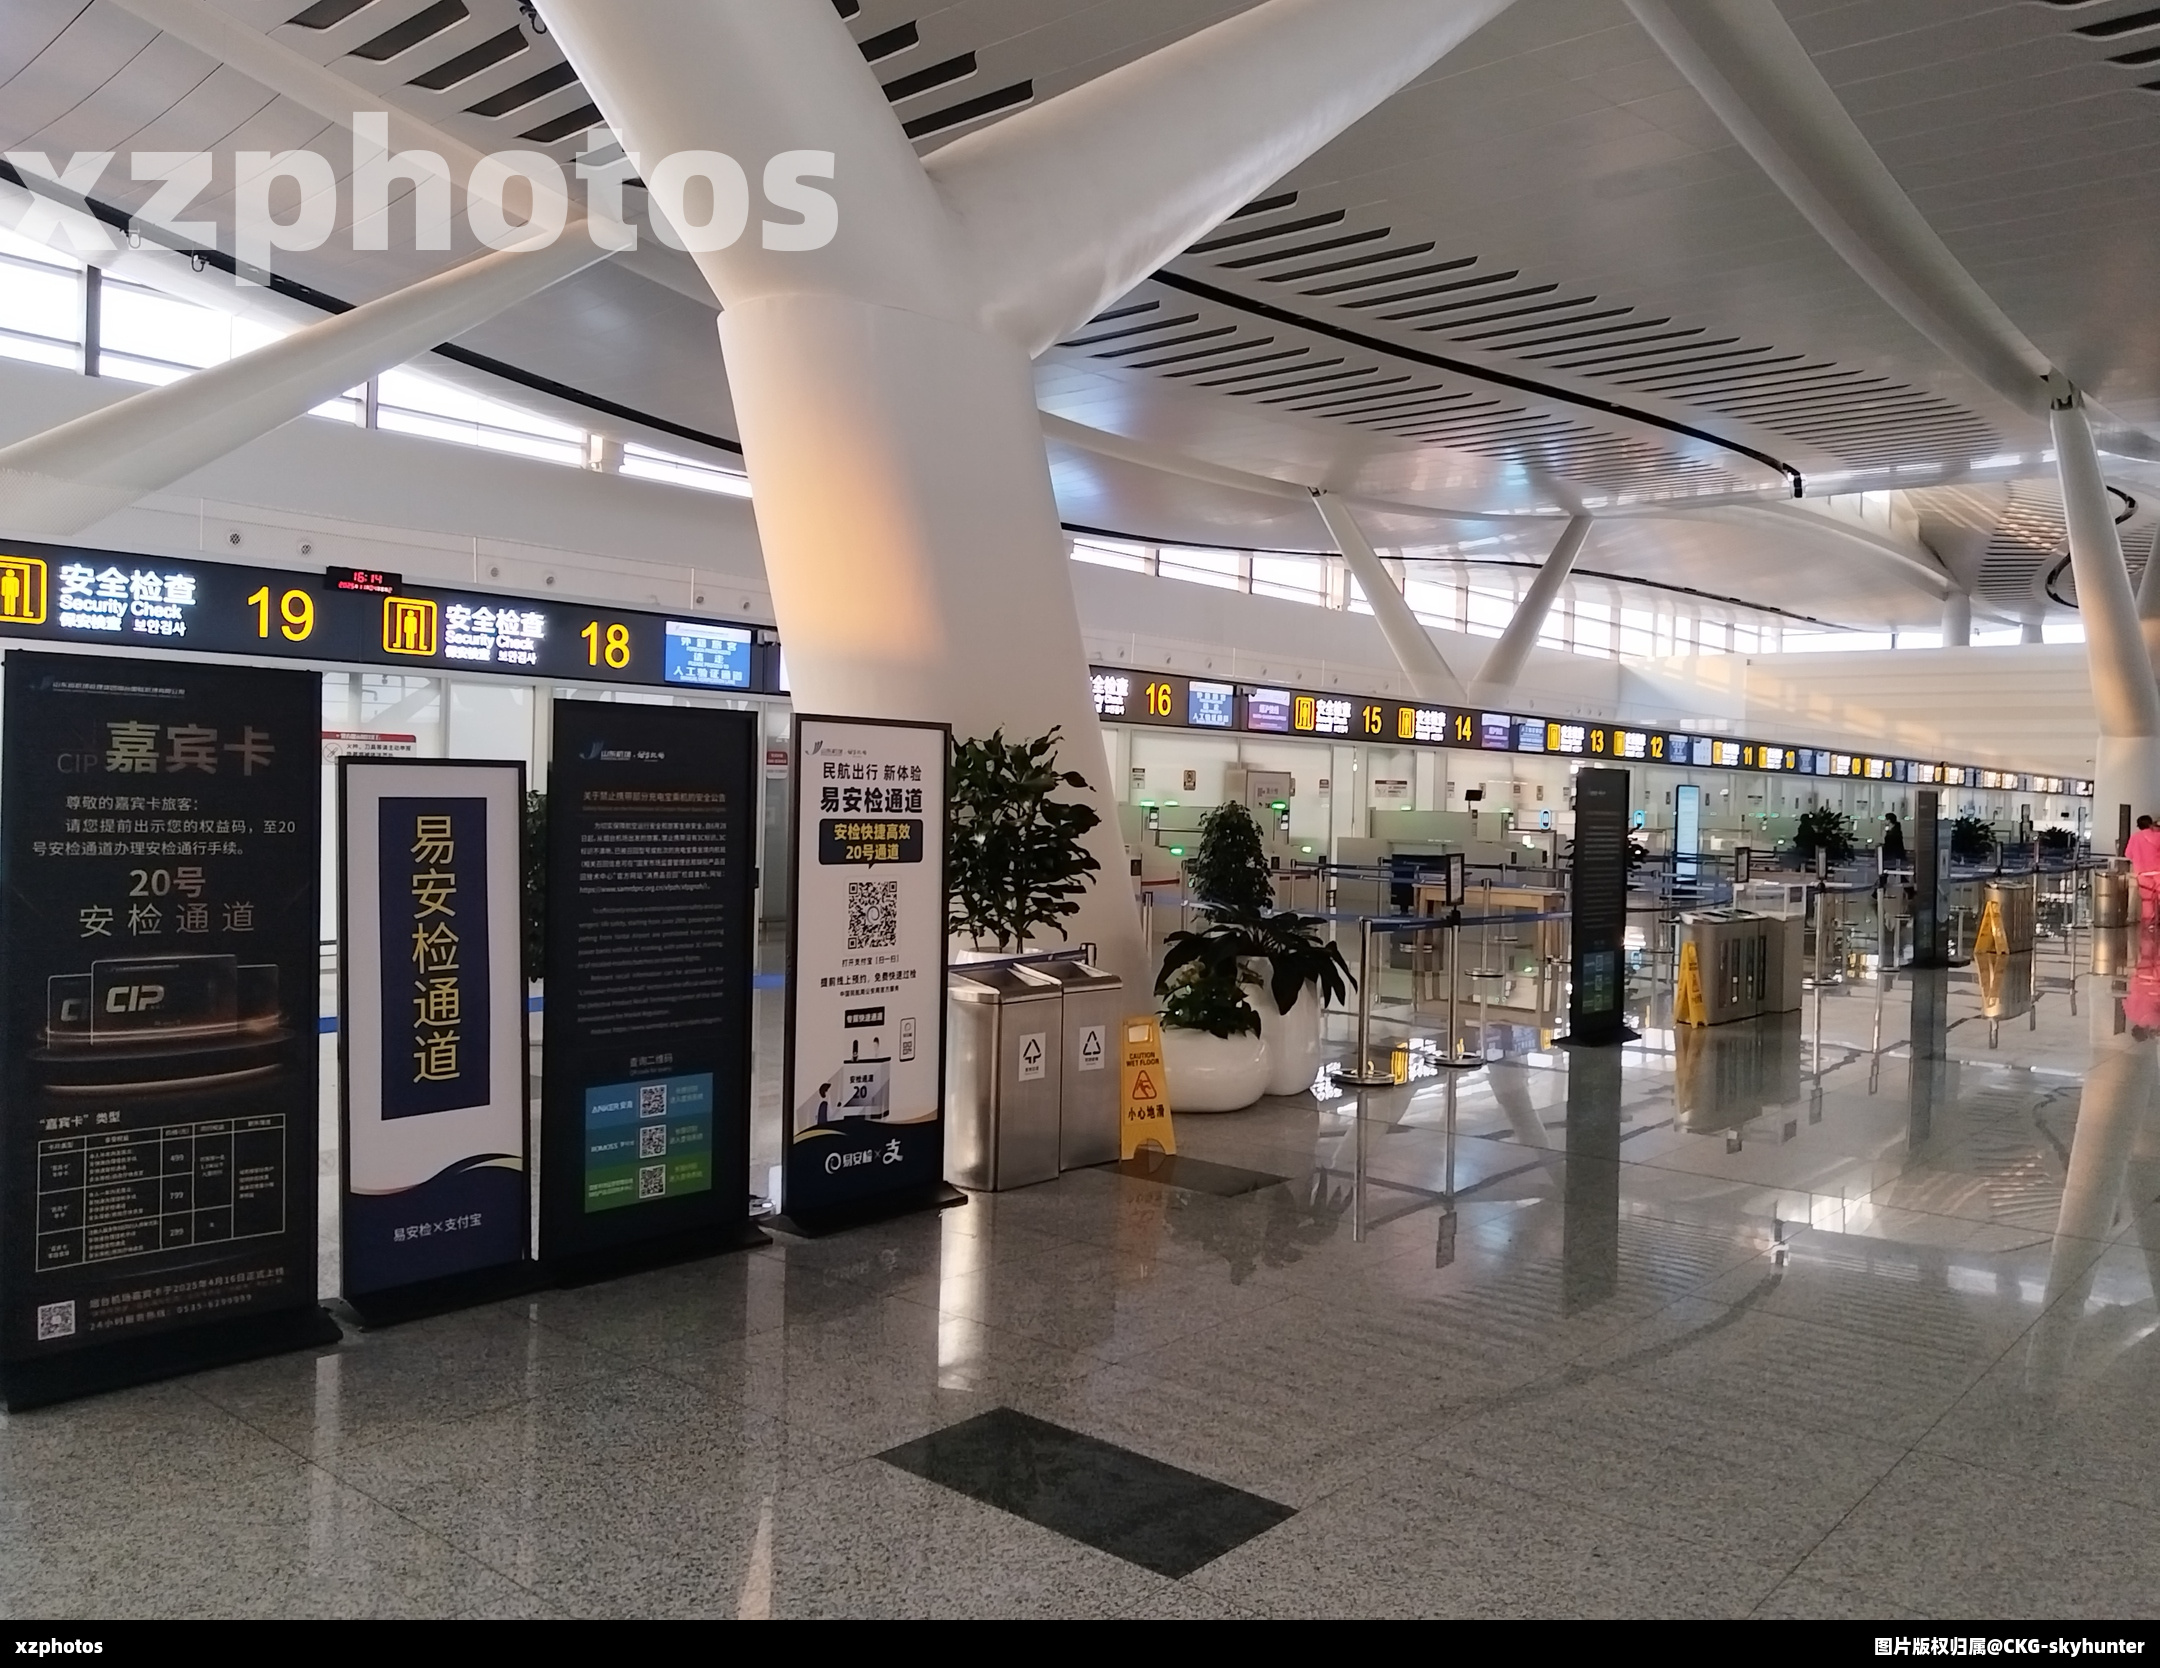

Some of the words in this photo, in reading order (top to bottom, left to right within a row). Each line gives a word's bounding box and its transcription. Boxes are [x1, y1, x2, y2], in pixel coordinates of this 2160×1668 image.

[59, 563, 196, 605] 安全检查
[353, 571, 383, 584] 16:14
[60, 594, 128, 618] Security
[131, 600, 183, 619] Check
[248, 586, 315, 641] 19
[132, 618, 187, 637] 보안검사
[445, 604, 545, 638] 安全检查
[445, 630, 495, 650] Security
[496, 635, 535, 651] Check
[581, 621, 631, 668] 18
[1089, 674, 1129, 697] 全检查
[1145, 682, 1172, 716] 16
[1362, 706, 1382, 734] 15
[1455, 715, 1472, 741] 14
[57, 753, 97, 774] CIP
[106, 720, 276, 776] 嘉宾卡
[1590, 729, 1604, 753] 13
[1650, 736, 1664, 758] 12
[823, 762, 878, 780] 民航出行
[883, 764, 922, 781] 新体验
[820, 787, 923, 813] 易安检通道
[65, 818, 296, 833] 请您提前出示您的权益码，至20
[834, 823, 911, 841] 安检快捷高效
[33, 841, 246, 856] 号安检通道办理安检通行手续。
[846, 843, 900, 861] 20号通道
[129, 866, 206, 898] 20号
[79, 901, 255, 938] 安检通道
[410, 815, 462, 1084] 易安检通道
[106, 985, 165, 1014] CIP
[1129, 1052, 1156, 1060] CAUTION
[1139, 1058, 1160, 1067] FLOOR
[854, 1086, 867, 1099] 20
[591, 1103, 619, 1114] ANKER
[1128, 1104, 1165, 1121] 小心地滑
[170, 1153, 184, 1162] 499
[169, 1190, 185, 1200] 799
